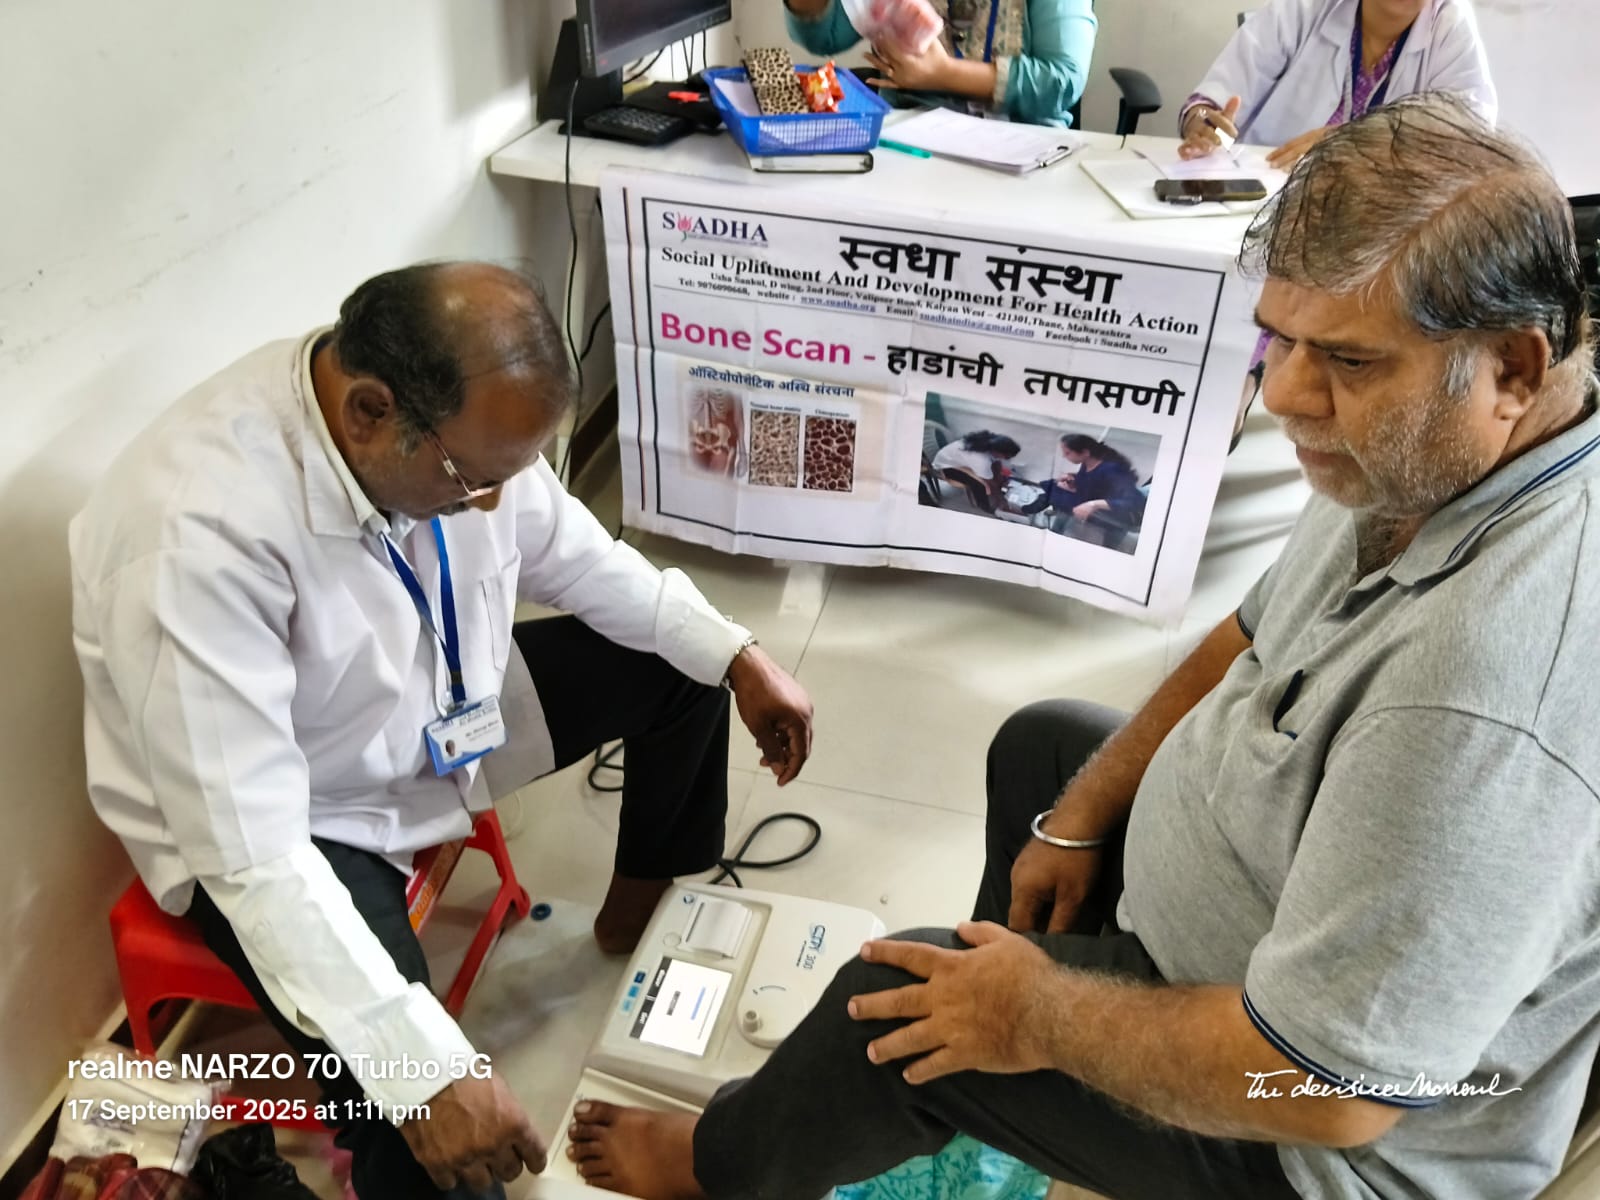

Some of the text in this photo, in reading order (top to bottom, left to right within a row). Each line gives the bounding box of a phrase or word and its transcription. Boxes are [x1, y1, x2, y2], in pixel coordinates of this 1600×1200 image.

[662, 247, 1199, 335] Social Upliftment And Development For Health Action
[839, 236, 1123, 304] स्वधा संस्था
[770, 280, 778, 288] D
[926, 301, 958, 315] Kalyan
[962, 305, 985, 317] West
[1067, 322, 1132, 339] Maharashtra
[661, 313, 752, 351] Bone
[762, 329, 850, 364] Scan
[887, 344, 1004, 387] हाडांची
[1023, 367, 1185, 416] तपासणी
[1140, 343, 1168, 355] NGO
